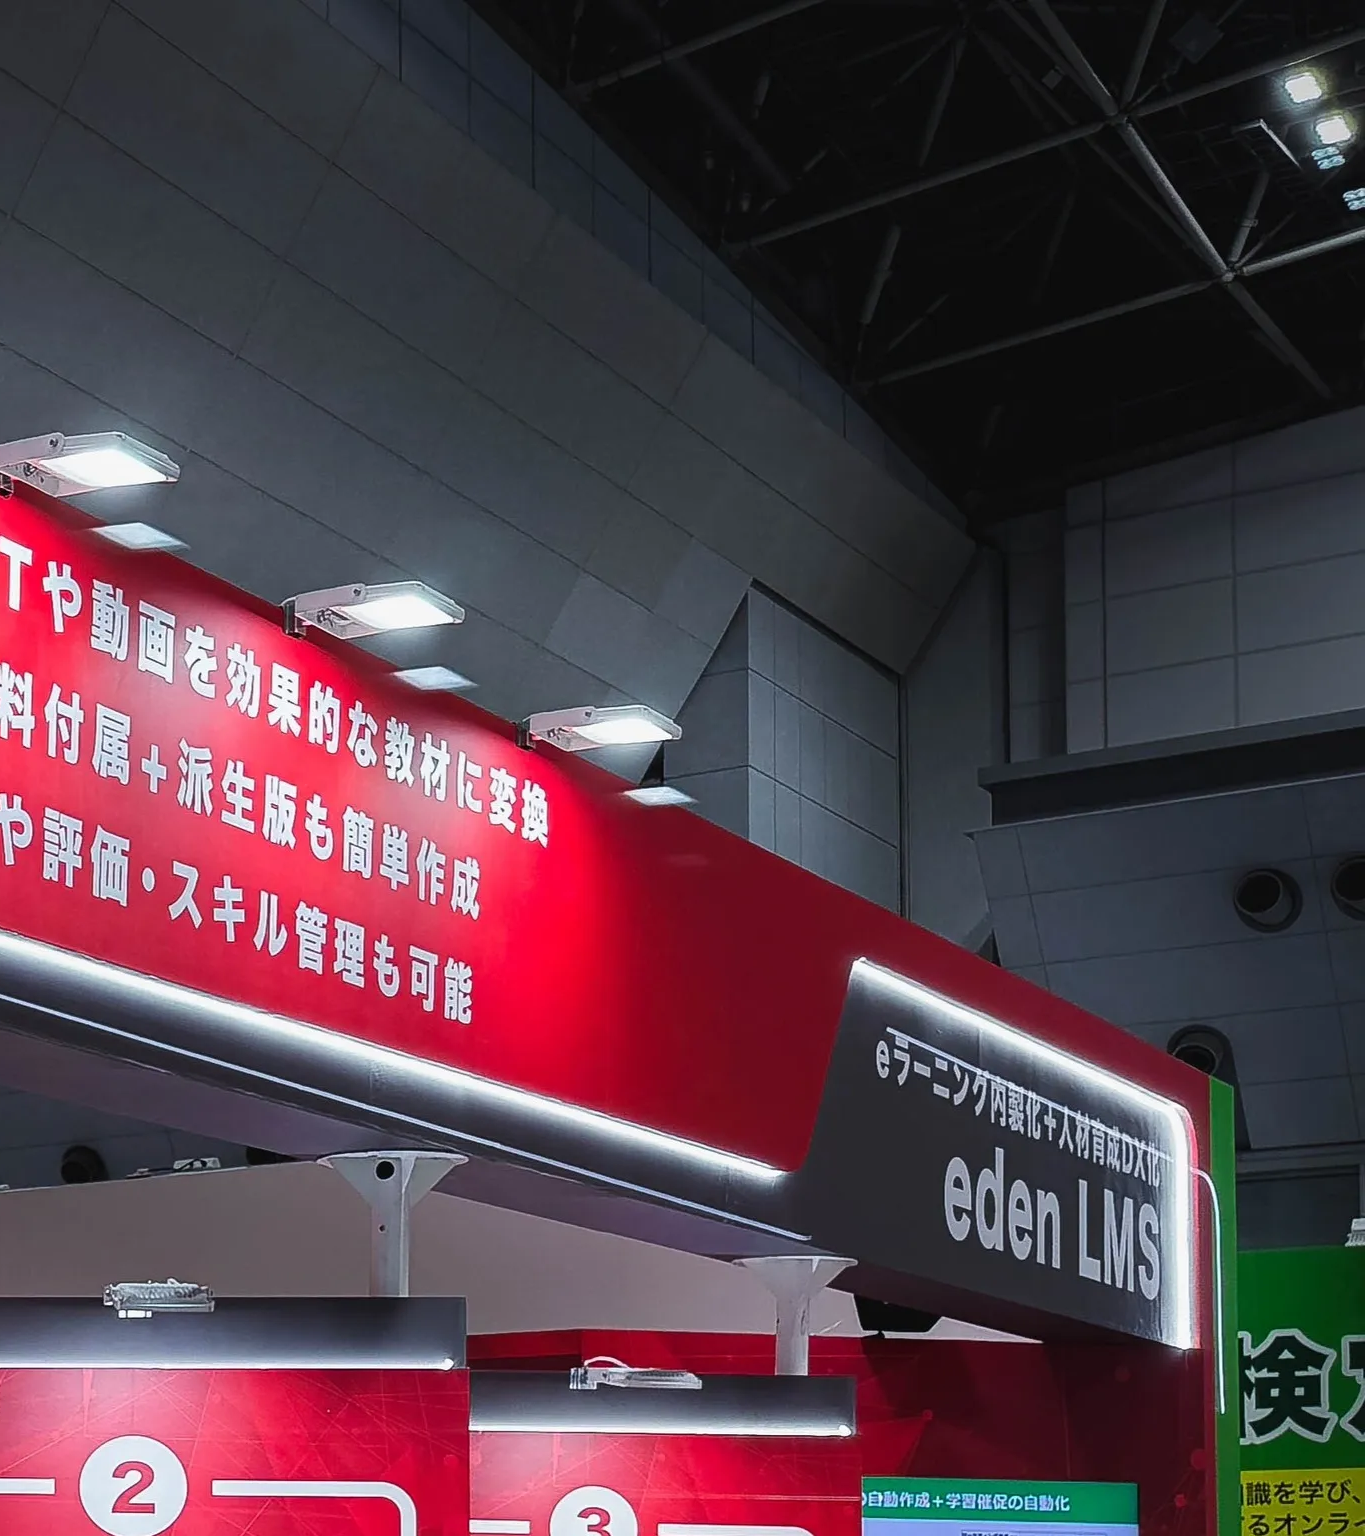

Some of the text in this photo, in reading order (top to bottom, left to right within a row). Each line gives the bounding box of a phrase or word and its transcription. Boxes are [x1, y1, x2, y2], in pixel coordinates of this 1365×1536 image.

[944, 1146, 1161, 1301] eden LMS
[862, 1490, 1070, 1512] 自動作成+学習催促の自動化
